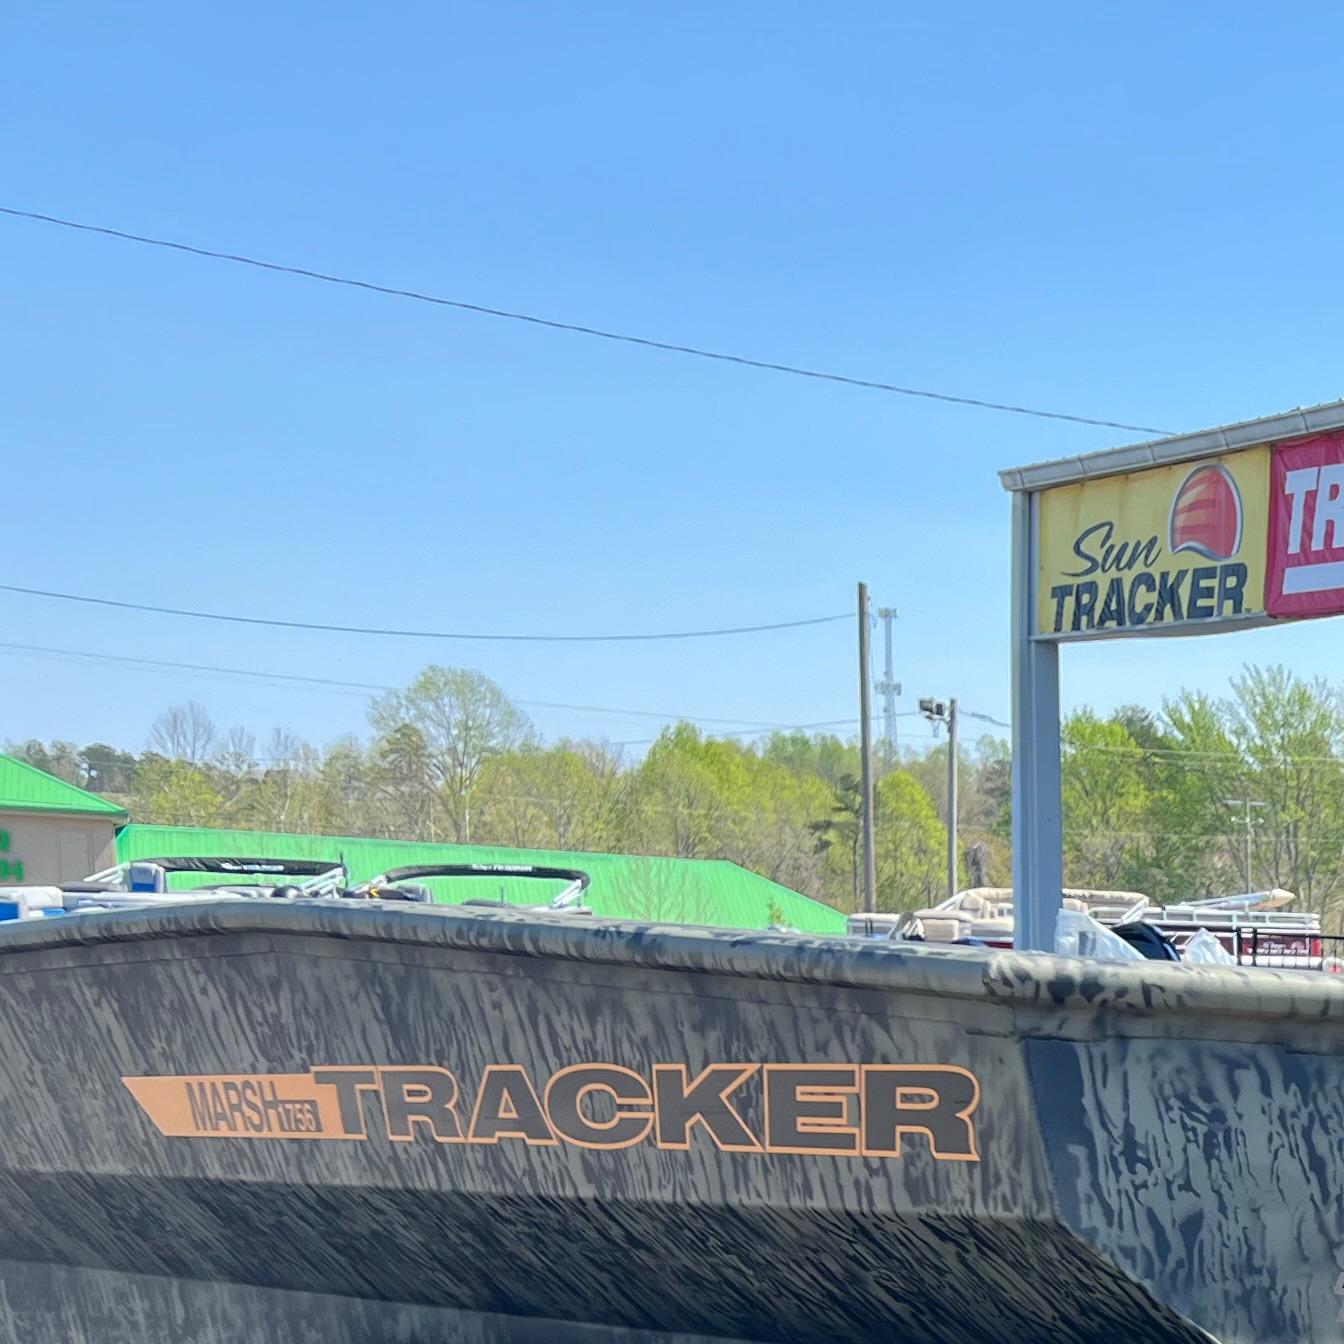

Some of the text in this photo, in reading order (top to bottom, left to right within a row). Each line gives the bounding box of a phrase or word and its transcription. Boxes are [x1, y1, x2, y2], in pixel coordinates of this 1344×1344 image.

[1061, 520, 1161, 576] Sun
[1050, 562, 1248, 633] TRACKER
[185, 1080, 317, 1133] MARSH 1756
[311, 1064, 981, 1161] TRACKER
